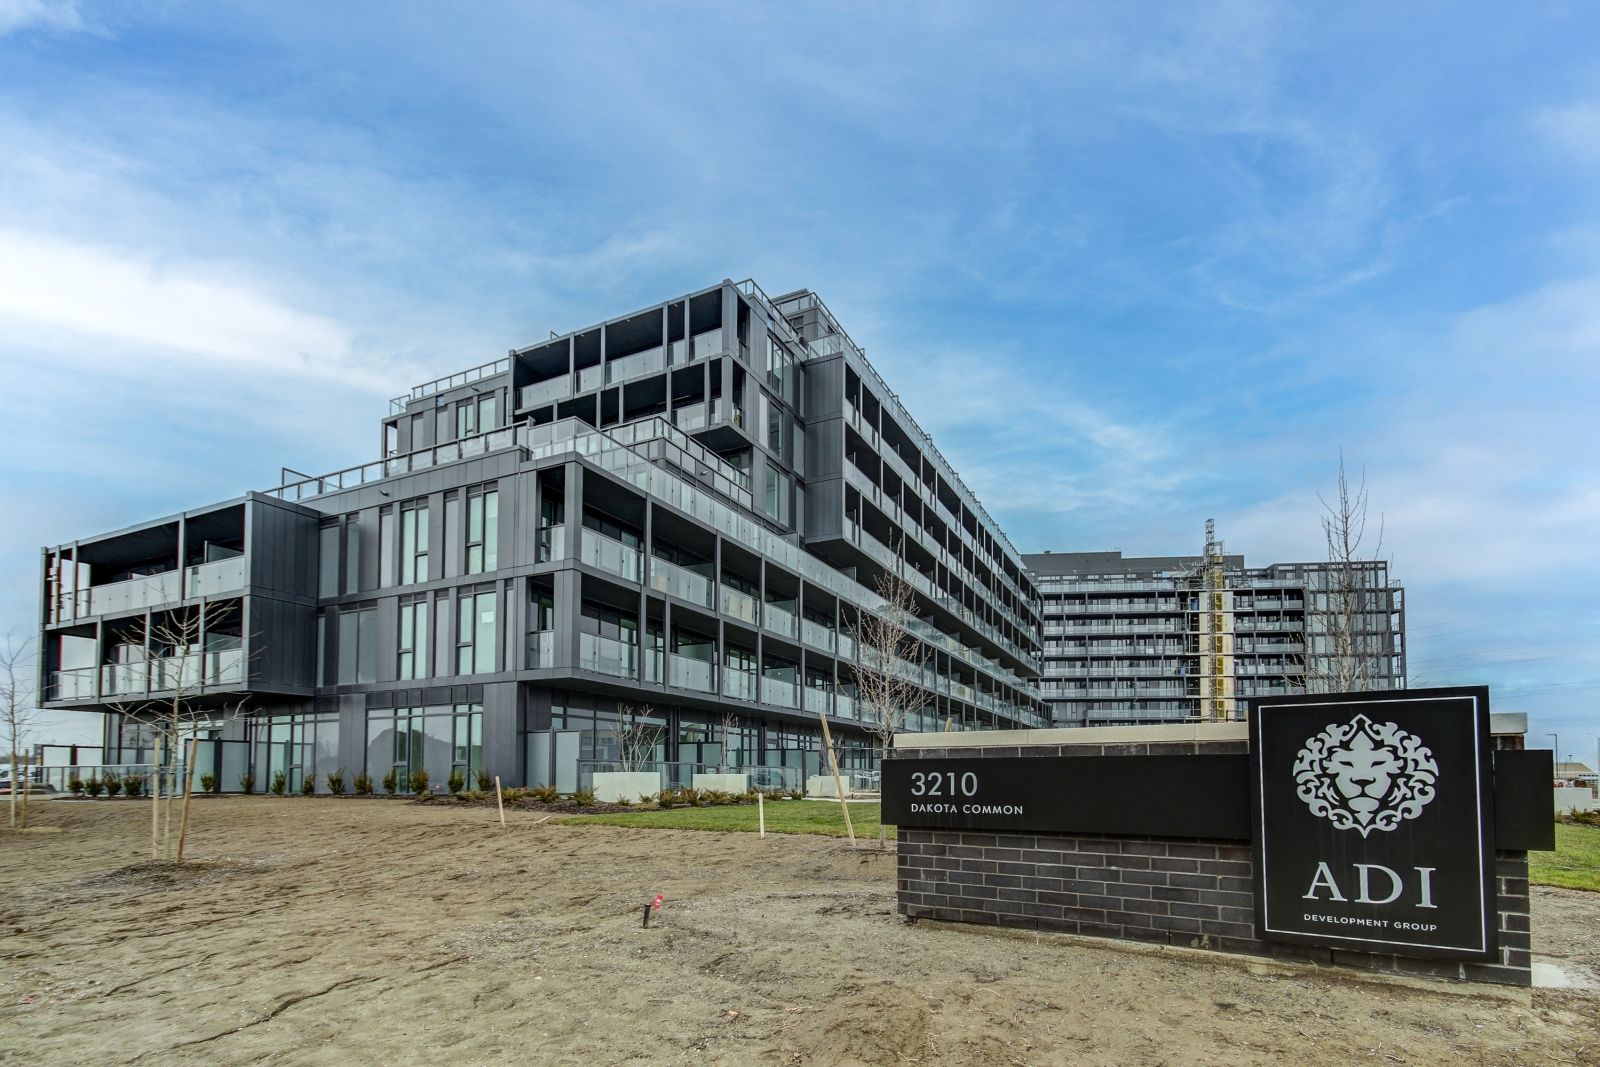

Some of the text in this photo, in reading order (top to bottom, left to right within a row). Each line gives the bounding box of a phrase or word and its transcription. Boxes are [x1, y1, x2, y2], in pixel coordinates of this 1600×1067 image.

[911, 772, 978, 797] 3210
[911, 803, 1023, 815] DAKOTA COMMON
[1301, 861, 1438, 909] ADI
[1303, 913, 1437, 932] DEVELOPMENT GROUP
